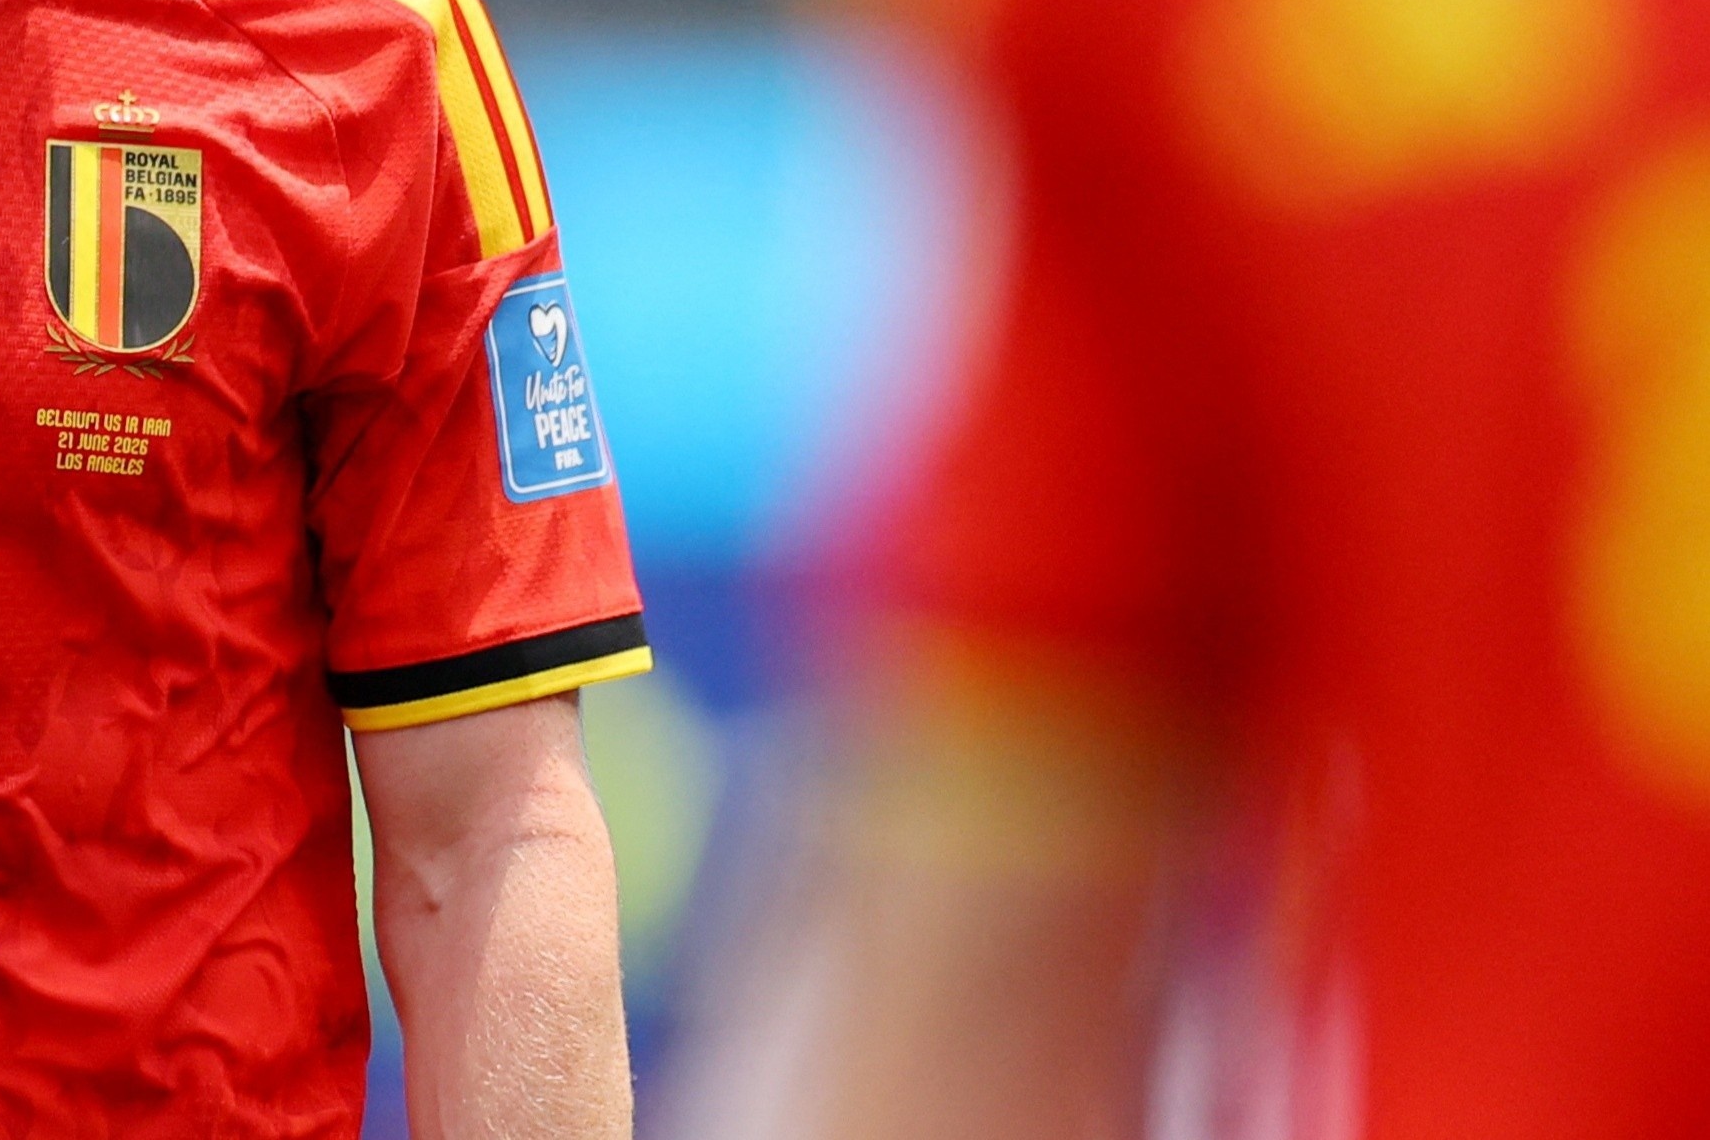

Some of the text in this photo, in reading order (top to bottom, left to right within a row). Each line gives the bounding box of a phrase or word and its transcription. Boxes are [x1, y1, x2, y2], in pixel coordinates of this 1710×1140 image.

[125, 151, 179, 169] ROYAL
[125, 168, 197, 188] BELGIAN
[125, 186, 197, 205] FA 1895
[36, 408, 100, 431] BELGIUM
[124, 415, 139, 435] IR
[142, 417, 172, 437] IRAN
[534, 403, 591, 449] PEACE
[57, 431, 149, 456] 21 JUNE 2026
[56, 451, 145, 476] LOS ANGELES
